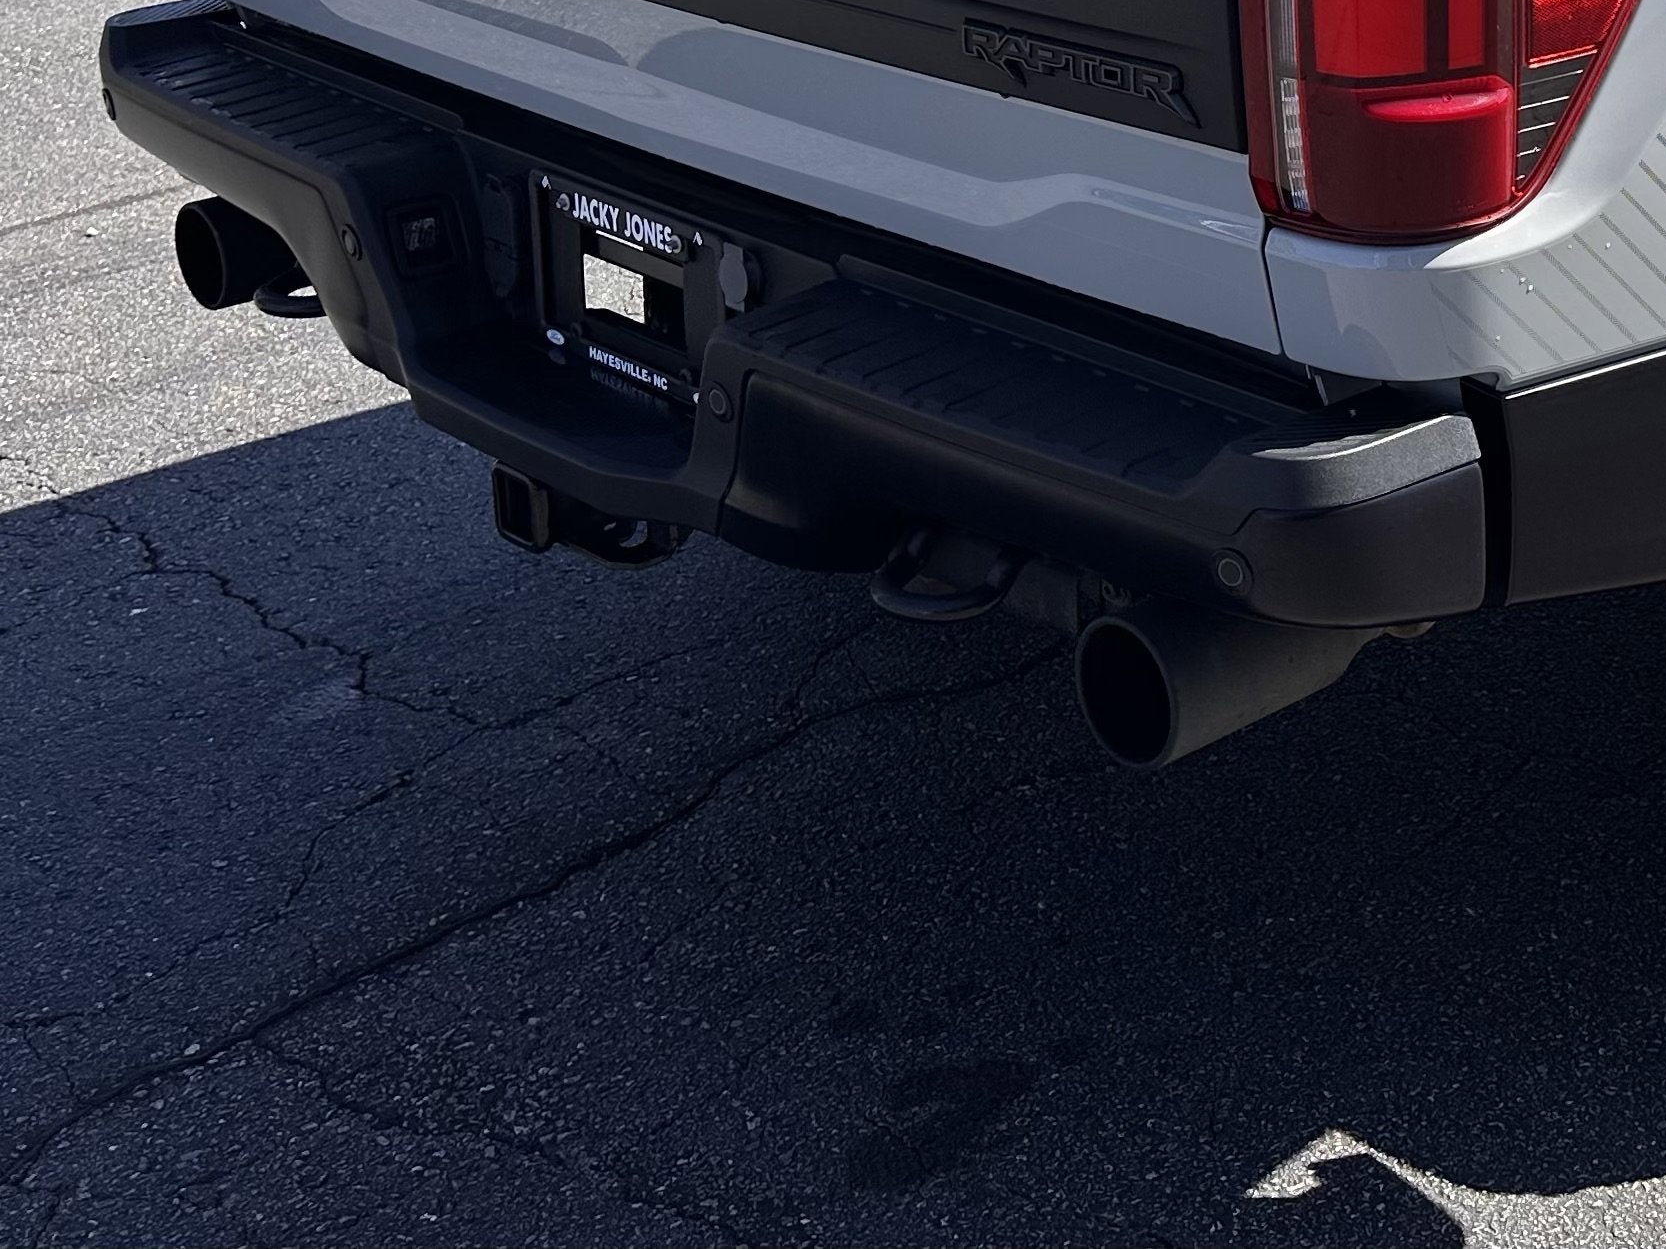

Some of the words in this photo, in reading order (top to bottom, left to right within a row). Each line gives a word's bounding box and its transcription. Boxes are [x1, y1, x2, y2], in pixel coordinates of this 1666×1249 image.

[962, 20, 1201, 129] RAPTOR
[572, 192, 619, 232] JACKY
[624, 211, 673, 254] JONES
[588, 345, 652, 383] HAYESVILLE,
[653, 373, 668, 391] NC
